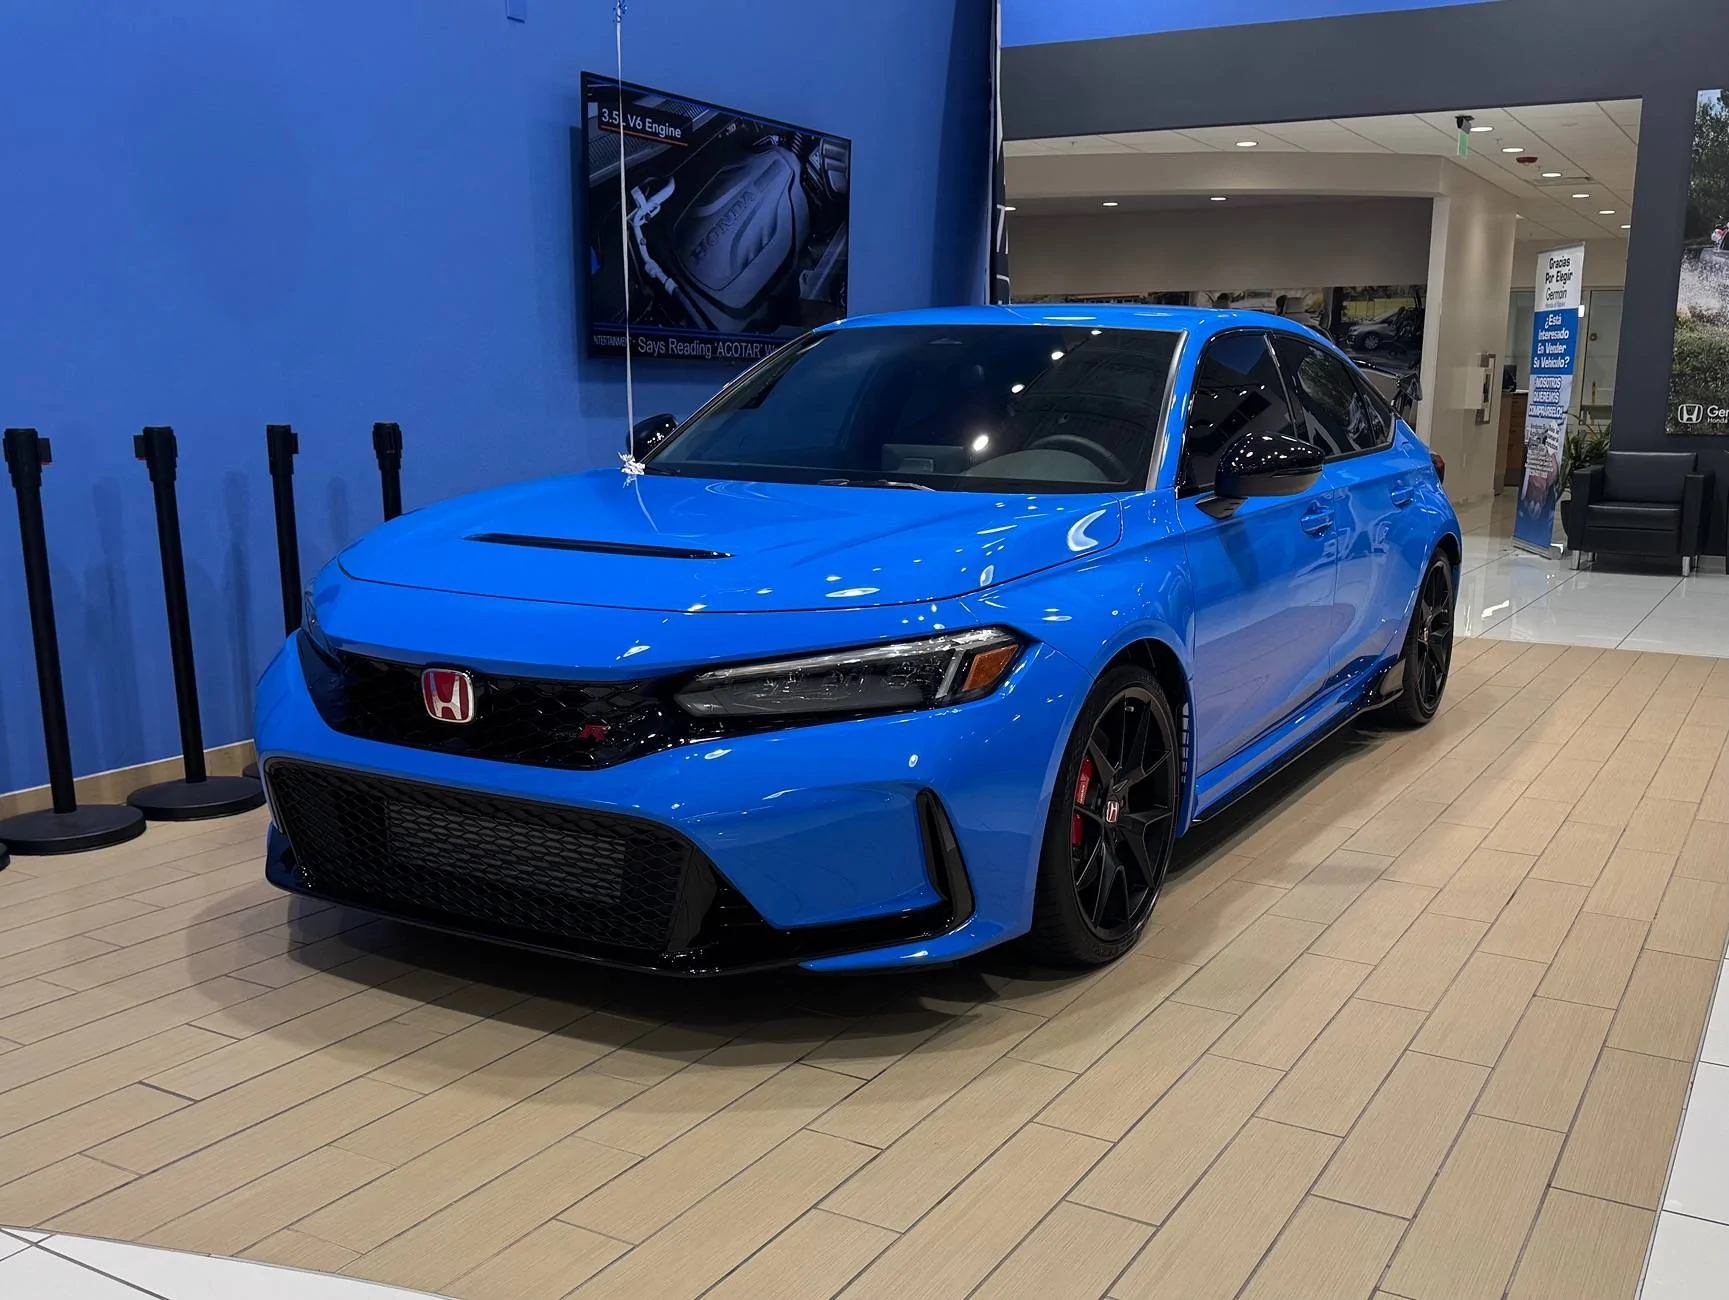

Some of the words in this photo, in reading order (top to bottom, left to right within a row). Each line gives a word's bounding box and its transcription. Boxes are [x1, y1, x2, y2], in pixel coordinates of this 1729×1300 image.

[628, 114, 643, 129] V6
[645, 118, 682, 138] Engine
[1549, 255, 1571, 270] Gracias
[1545, 272, 1555, 284] Por
[1556, 269, 1573, 285] Elegir
[1538, 327, 1569, 340] Interesado
[638, 336, 666, 356] Says
[668, 338, 712, 358] Reading
